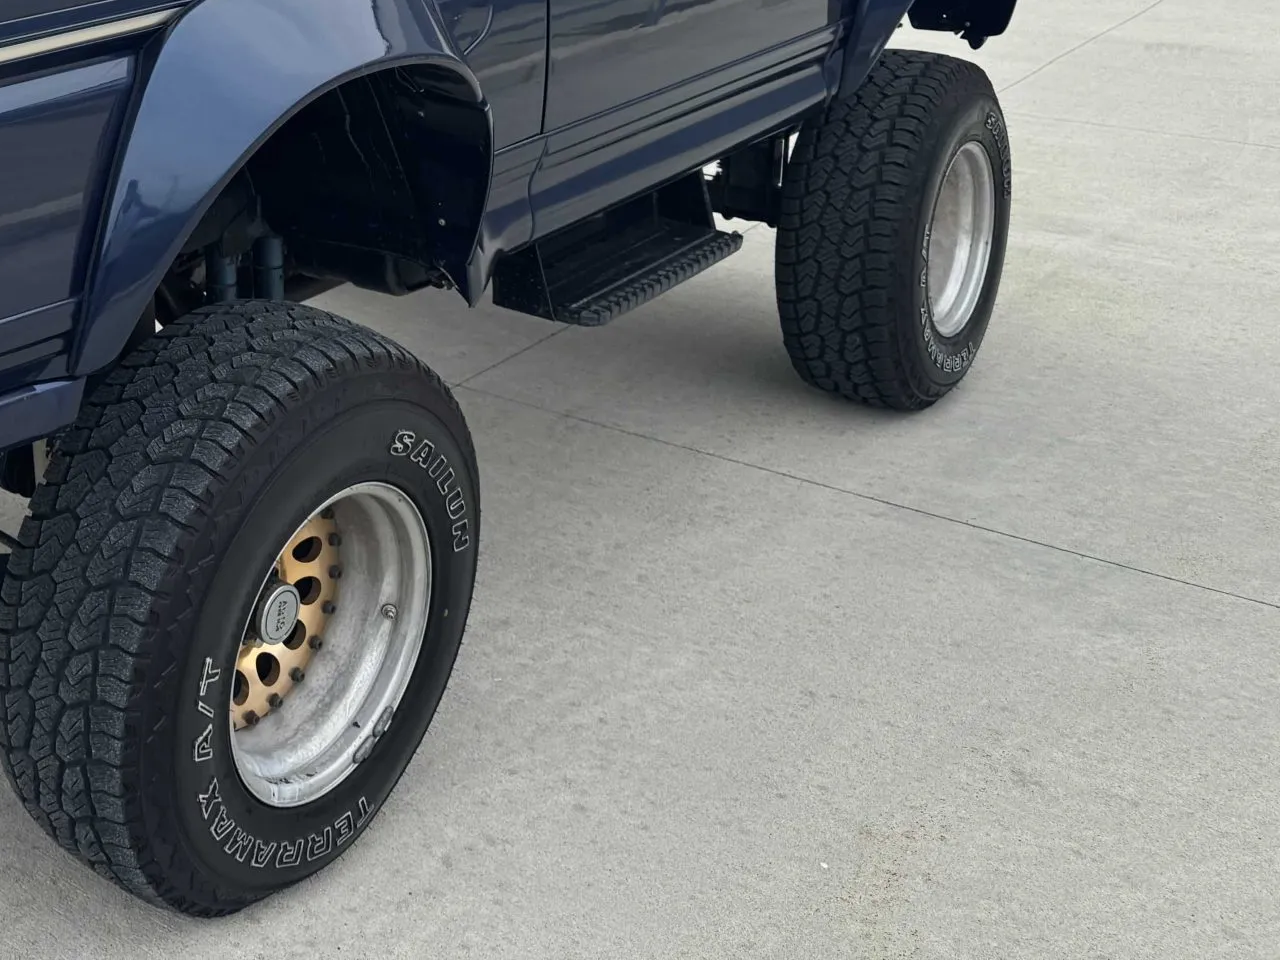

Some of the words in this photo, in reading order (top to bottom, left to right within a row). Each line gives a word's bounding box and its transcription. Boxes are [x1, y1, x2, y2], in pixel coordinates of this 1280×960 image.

[390, 429, 470, 552] SAILUN
[194, 657, 221, 762] A/T
[197, 777, 374, 868] TERRAMAX
